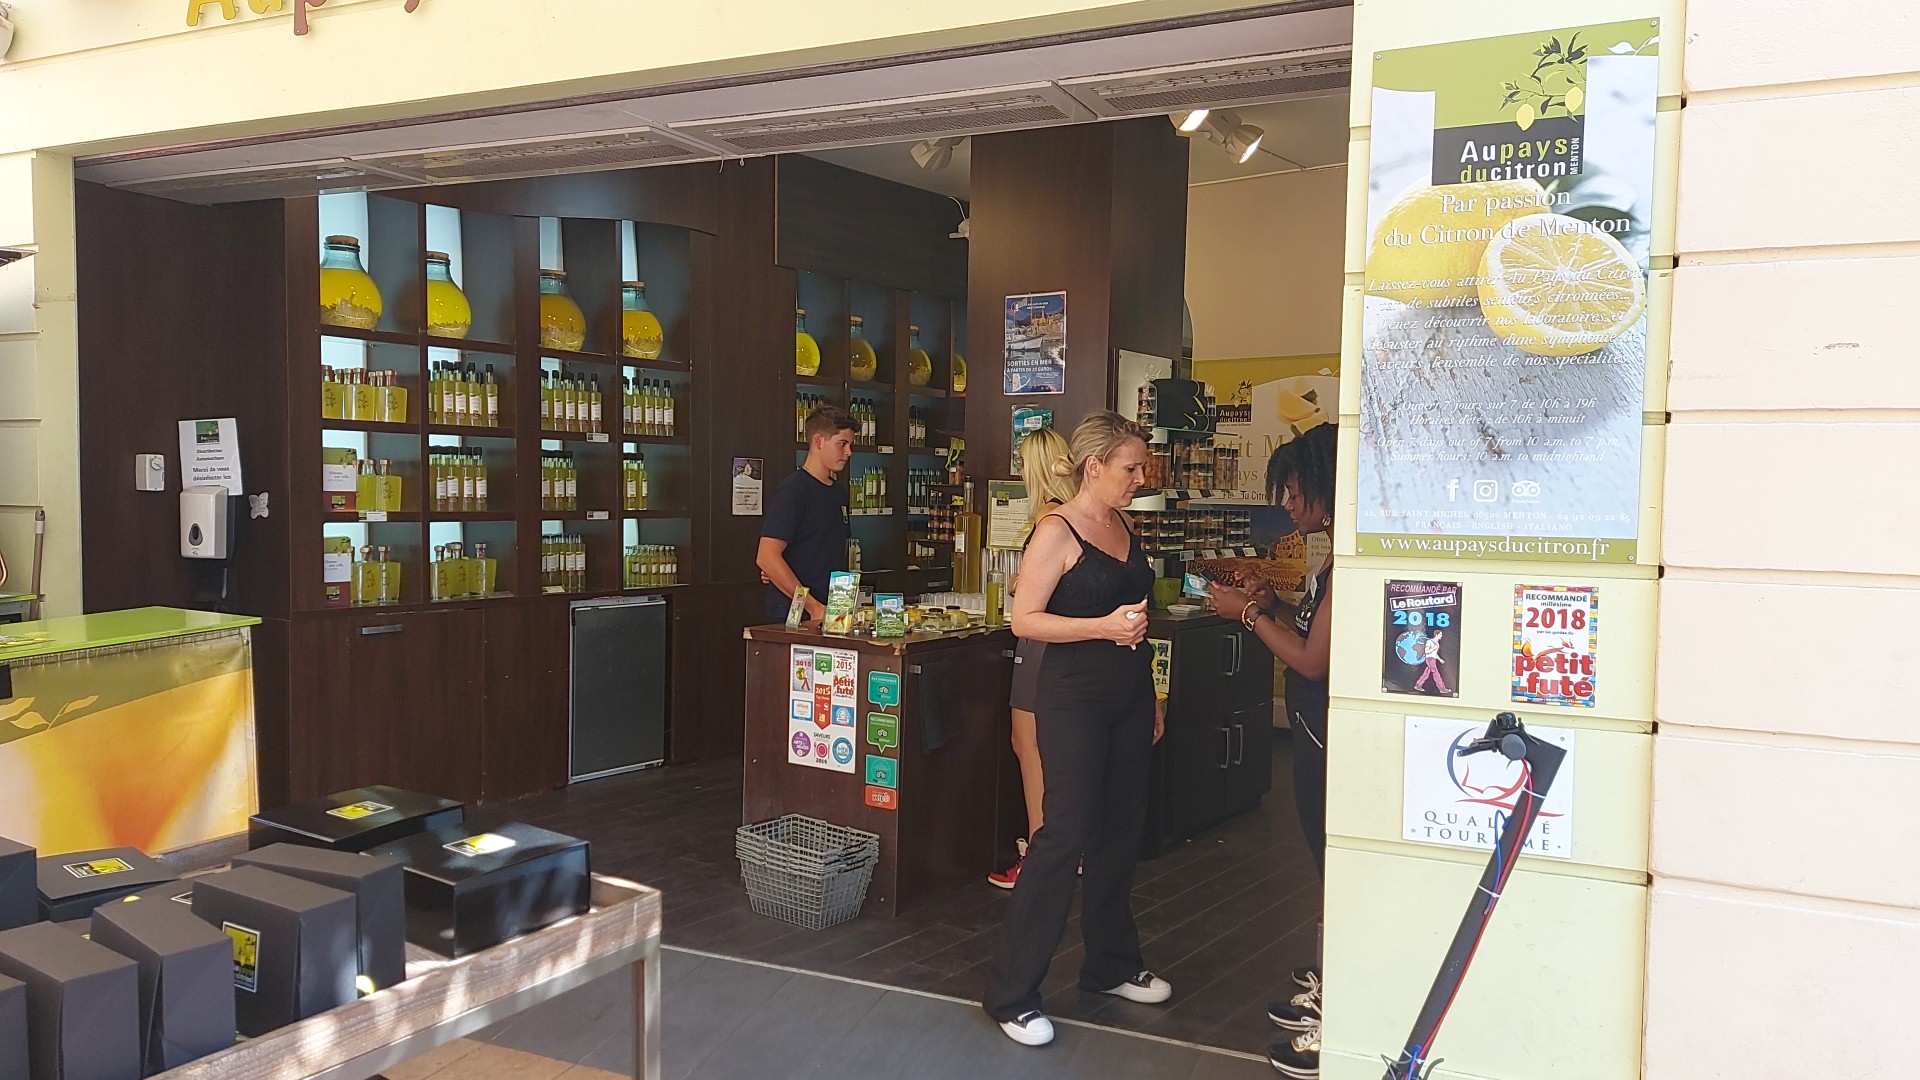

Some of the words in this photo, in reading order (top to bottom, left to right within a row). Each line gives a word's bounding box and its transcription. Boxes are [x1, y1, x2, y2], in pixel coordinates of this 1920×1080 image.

[1570, 137, 1580, 175] MENTON
[1440, 194, 1477, 214] Par
[1485, 190, 1571, 216] passion
[1384, 229, 1412, 247] du
[1420, 224, 1494, 244] Citron
[1501, 221, 1531, 240] de
[1539, 217, 1631, 236] Menton
[1368, 278, 1451, 291] Laissez-vous
[1456, 275, 1500, 286] attirer
[1507, 272, 1525, 284] Au
[1532, 271, 1565, 286] Pays
[1571, 268, 1592, 280] du
[1597, 267, 1644, 280] Citron
[1406, 296, 1422, 310] de
[1427, 294, 1478, 308] subtiles
[1484, 294, 1541, 306] senteurs
[1381, 319, 1418, 331] Venez
[1424, 315, 1490, 329] découvrir
[1495, 317, 1518, 327] nos
[1524, 311, 1605, 325] laboratoires
[1612, 311, 1626, 321] et
[1367, 336, 1422, 354] déguster
[1427, 339, 1442, 349] au
[1448, 334, 1497, 352] rythme
[1541, 332, 1617, 349] symphonie
[1622, 332, 1640, 344] de
[1503, 354, 1519, 367] de
[1524, 356, 1548, 367] nos
[1402, 400, 1440, 411] Ouvert
[1444, 400, 1451, 410] 7
[1451, 401, 1483, 414] jours
[1488, 402, 1506, 411] sur
[1510, 400, 1517, 409] 7
[1521, 399, 1535, 409] de
[1540, 398, 1561, 409] 10h
[1576, 398, 1597, 408] 19h
[1410, 414, 1455, 425] Horaires
[1494, 414, 1508, 424] de
[1512, 413, 1533, 424] 10h
[1547, 414, 1586, 424] minuit
[1377, 437, 1404, 452] Open
[1420, 437, 1444, 450] days
[1449, 439, 1465, 448] out
[1470, 436, 1485, 450] of
[1492, 436, 1521, 450] from
[1526, 437, 1539, 447] 10
[1544, 438, 1565, 447] a.m.
[1570, 438, 1581, 446] to
[1586, 437, 1593, 447] 7
[1596, 438, 1620, 450] p.m.
[1391, 451, 1434, 462] Summer
[1475, 451, 1488, 462] 10
[1492, 453, 1513, 462] a.m.
[1518, 453, 1529, 461] to
[1533, 450, 1607, 463] midnightand
[1400, 510, 1429, 518] SAINT
[1472, 511, 1501, 521] 06500
[1503, 511, 1549, 520] MENTON
[1557, 513, 1569, 522] 04
[1572, 513, 1585, 522] 92
[1588, 513, 1601, 523] 09
[1619, 512, 1631, 523] 85
[1414, 521, 1462, 531] FRANÇAIS
[1471, 522, 1513, 531] ENGLISH
[1524, 523, 1573, 532] ITALIANO
[1380, 534, 1610, 561] www.aupaysducitron.fr
[1390, 583, 1441, 594] RECOMMANDÉ
[1526, 592, 1588, 603] RECOMMANDÉ
[1392, 610, 1450, 628] 2018
[1526, 607, 1586, 630] 2018
[836, 661, 853, 670] 2015
[1515, 652, 1594, 676] petit
[1527, 671, 1593, 698] futé
[1424, 811, 1551, 835] QUALÉ
